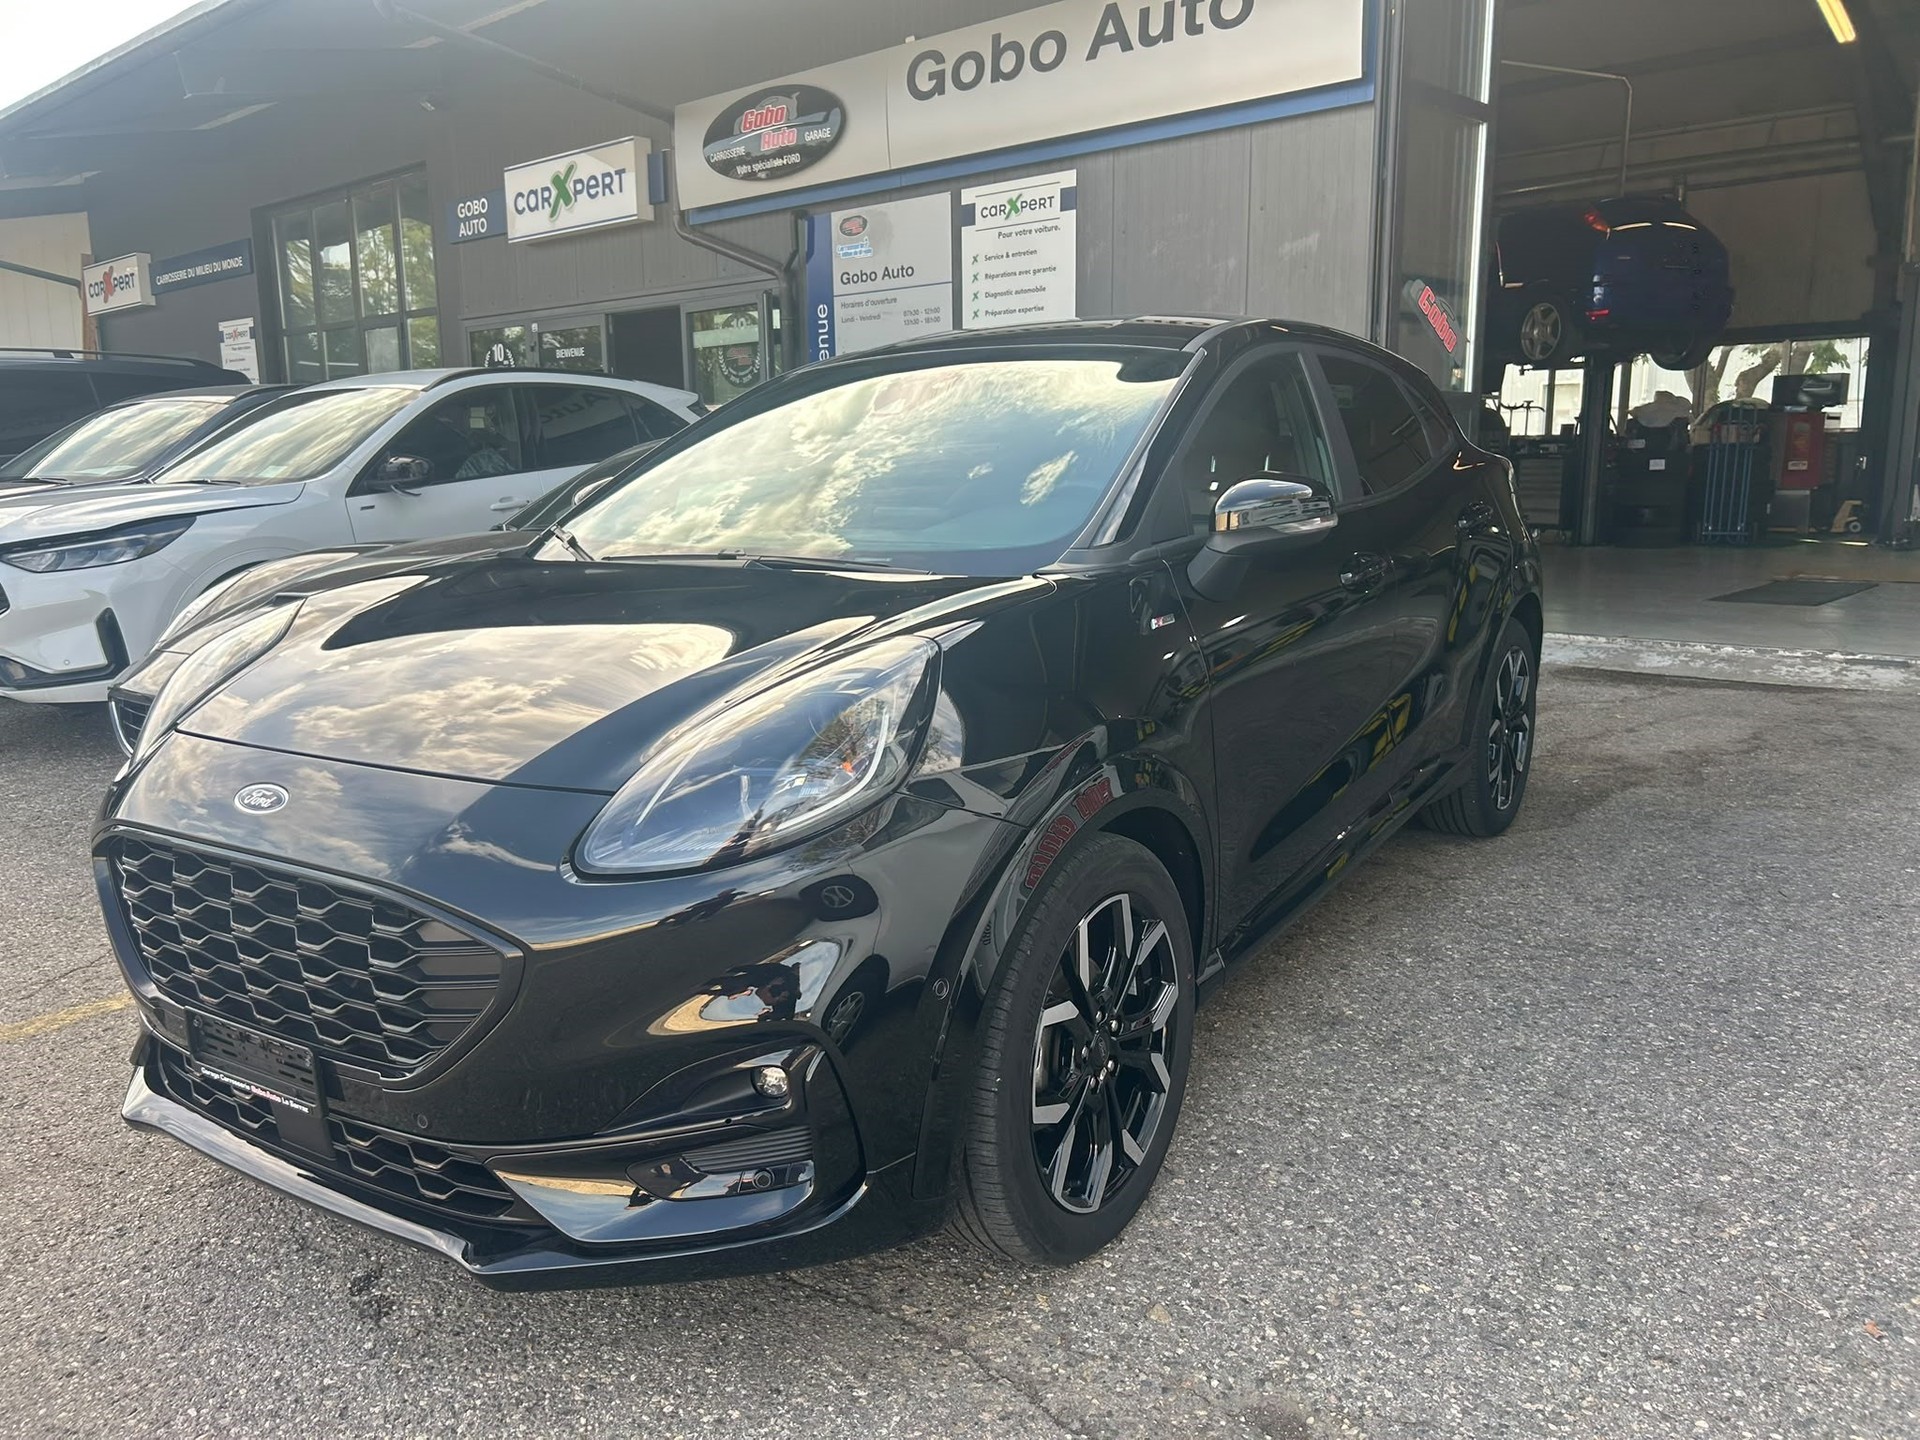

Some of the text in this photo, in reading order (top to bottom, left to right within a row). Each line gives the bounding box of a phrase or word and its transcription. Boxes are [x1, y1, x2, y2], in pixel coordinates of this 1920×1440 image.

[906, 0, 1254, 101] Gobo Auto
[741, 105, 787, 133] Gobo
[761, 128, 797, 151] Auto
[804, 127, 831, 142] GARAGE
[710, 146, 746, 163] CARROSSERIE
[457, 198, 488, 218] GOBO
[459, 217, 488, 238] AUTO
[998, 225, 1061, 239] Pour votre voiture.
[984, 253, 1004, 262] Service
[1011, 249, 1038, 258] entretien
[156, 256, 243, 285] CARROSSERIE DU MILIEU DU MONDE
[840, 264, 915, 285] Gobo Auto
[984, 270, 1017, 280] Réparations
[1033, 265, 1057, 276] garantie
[984, 285, 1046, 299] Diagnostic automobile
[984, 304, 1044, 317] Préparation expertise
[1418, 286, 1457, 353] Gobo
[492, 343, 505, 362] 10
[555, 346, 585, 359] BIENVENUE
[244, 789, 278, 808] Ford
